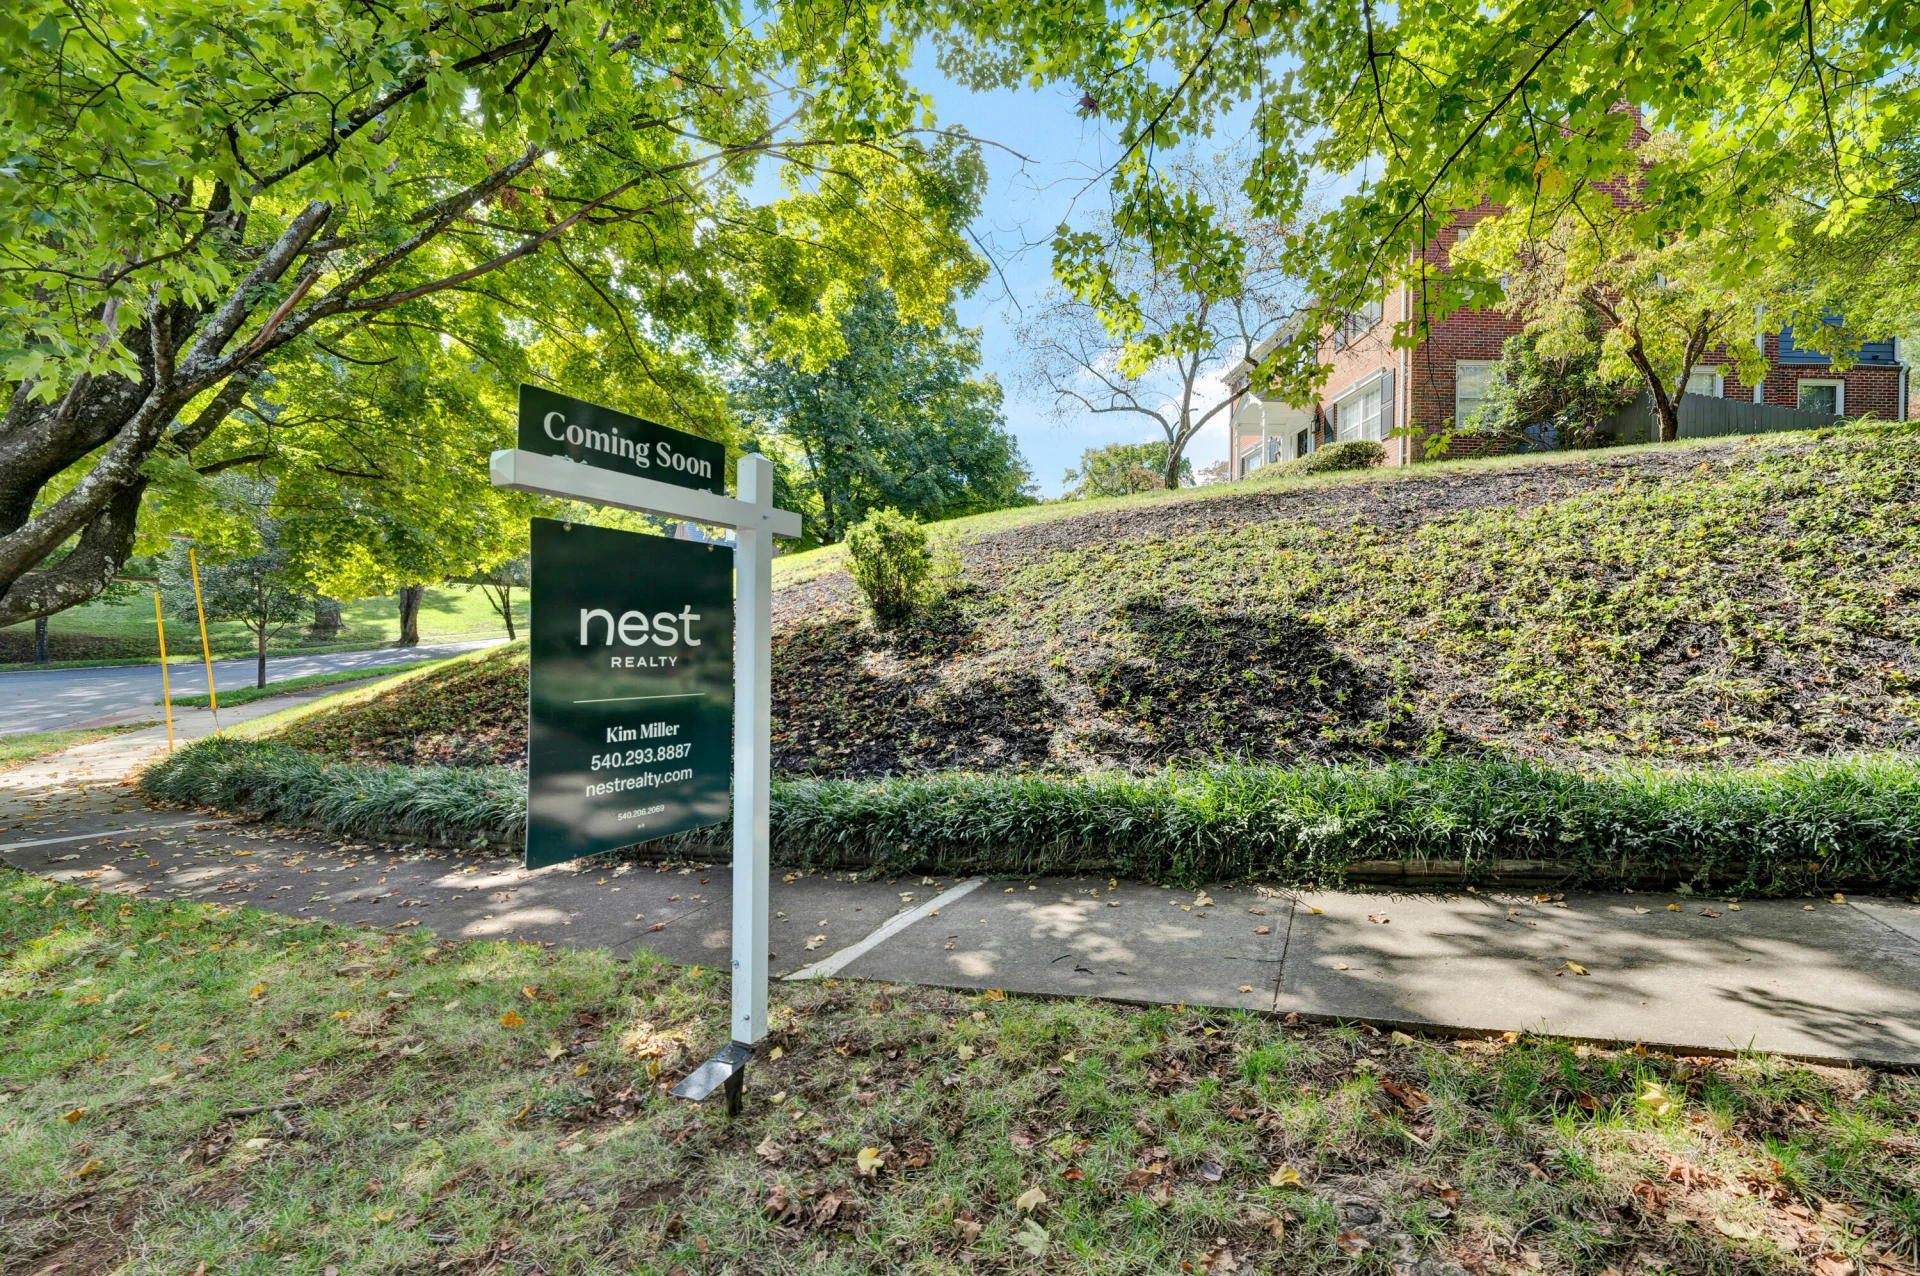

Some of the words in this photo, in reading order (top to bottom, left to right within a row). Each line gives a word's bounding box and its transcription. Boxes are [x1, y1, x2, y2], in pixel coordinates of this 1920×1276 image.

[543, 411, 650, 468] Coming
[656, 441, 712, 478] Soon
[580, 604, 702, 647] nest
[611, 656, 678, 668] REALTY
[606, 726, 637, 743] Kim
[640, 721, 680, 740] Miller
[590, 743, 692, 771] 540.293.8887
[585, 768, 693, 797] nestrealty.com
[617, 804, 665, 821] 540.206.2069
